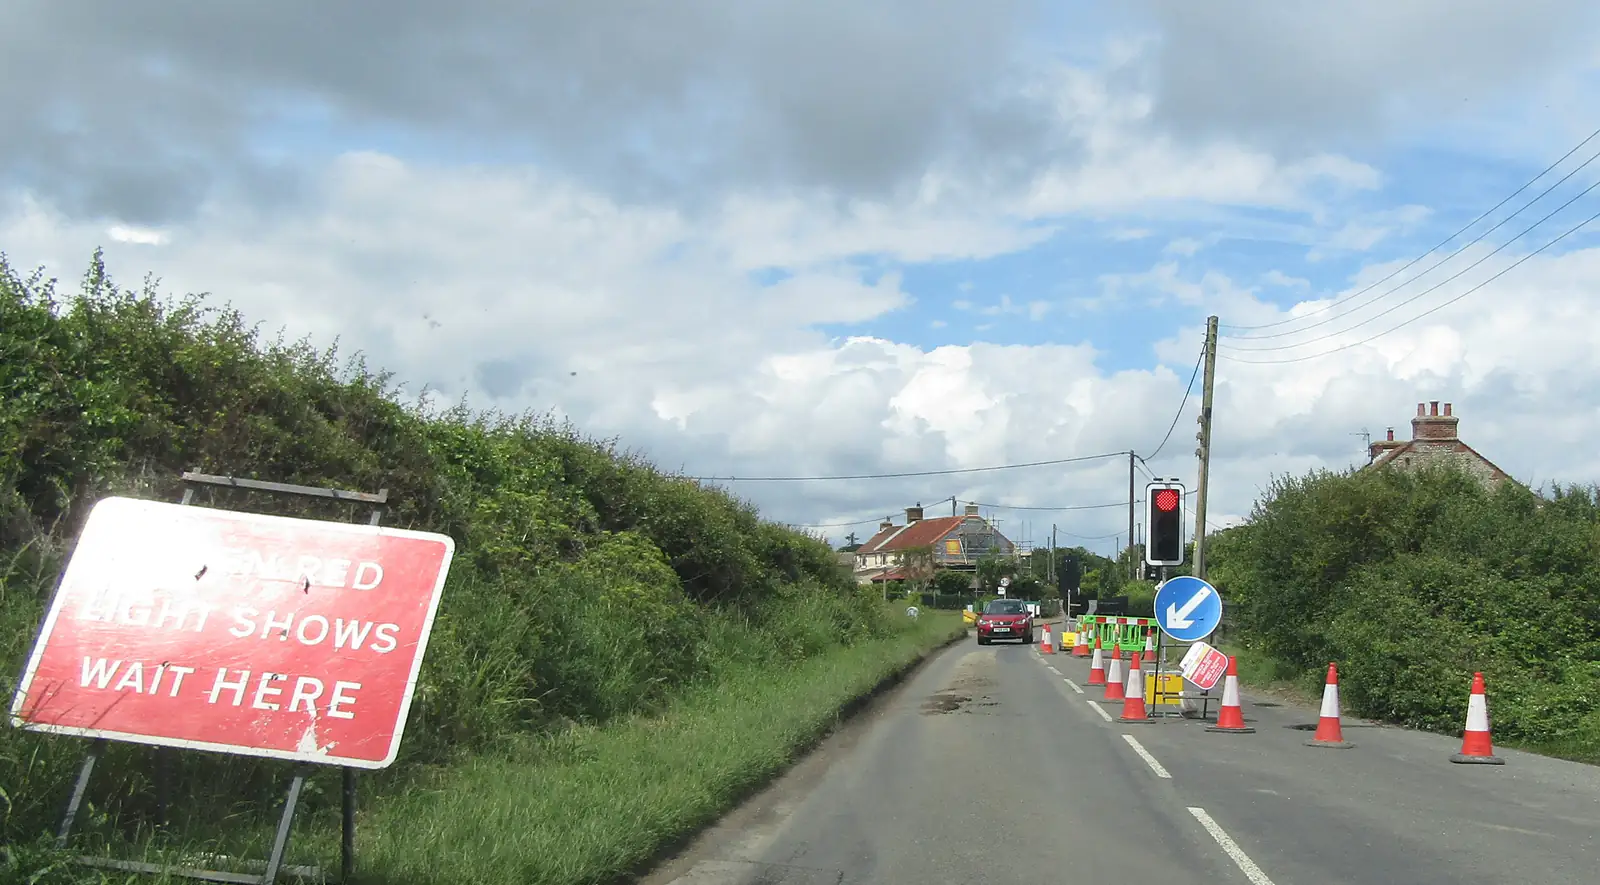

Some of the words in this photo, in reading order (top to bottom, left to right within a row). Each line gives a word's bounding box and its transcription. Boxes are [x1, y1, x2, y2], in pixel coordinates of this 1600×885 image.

[298, 555, 384, 590] RED
[79, 588, 214, 632] LIGHT
[229, 604, 400, 653] SHOWS
[80, 656, 194, 697] WAIT
[205, 667, 361, 719] HERE
